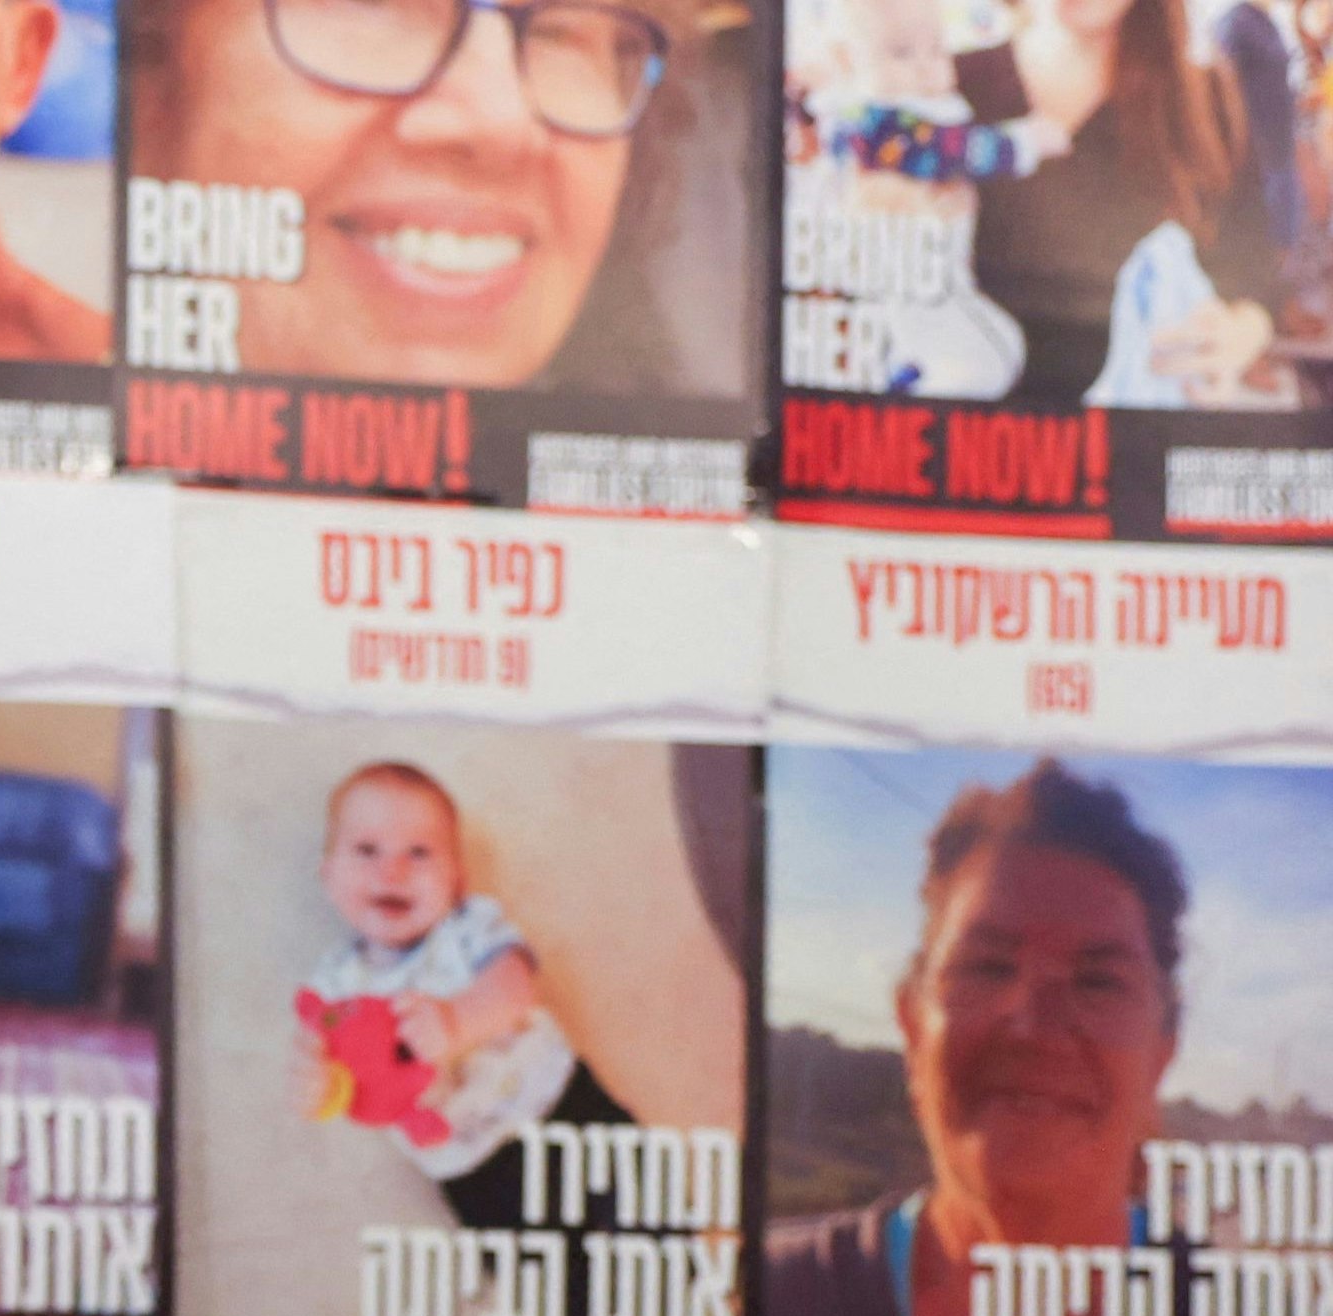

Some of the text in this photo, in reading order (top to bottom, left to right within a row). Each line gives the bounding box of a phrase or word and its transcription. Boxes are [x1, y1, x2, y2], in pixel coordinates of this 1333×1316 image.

[125, 176, 307, 282] BRING
[125, 275, 241, 374] HER
[126, 378, 289, 481] HOME
[301, 388, 473, 492] NOW!
[782, 400, 935, 498] HOME
[947, 405, 1110, 510] NOW!
[316, 530, 568, 619] כפיר ביבס
[847, 559, 1288, 650] מעיינה הרשקוביץ
[517, 1121, 743, 1233] תחזירו
